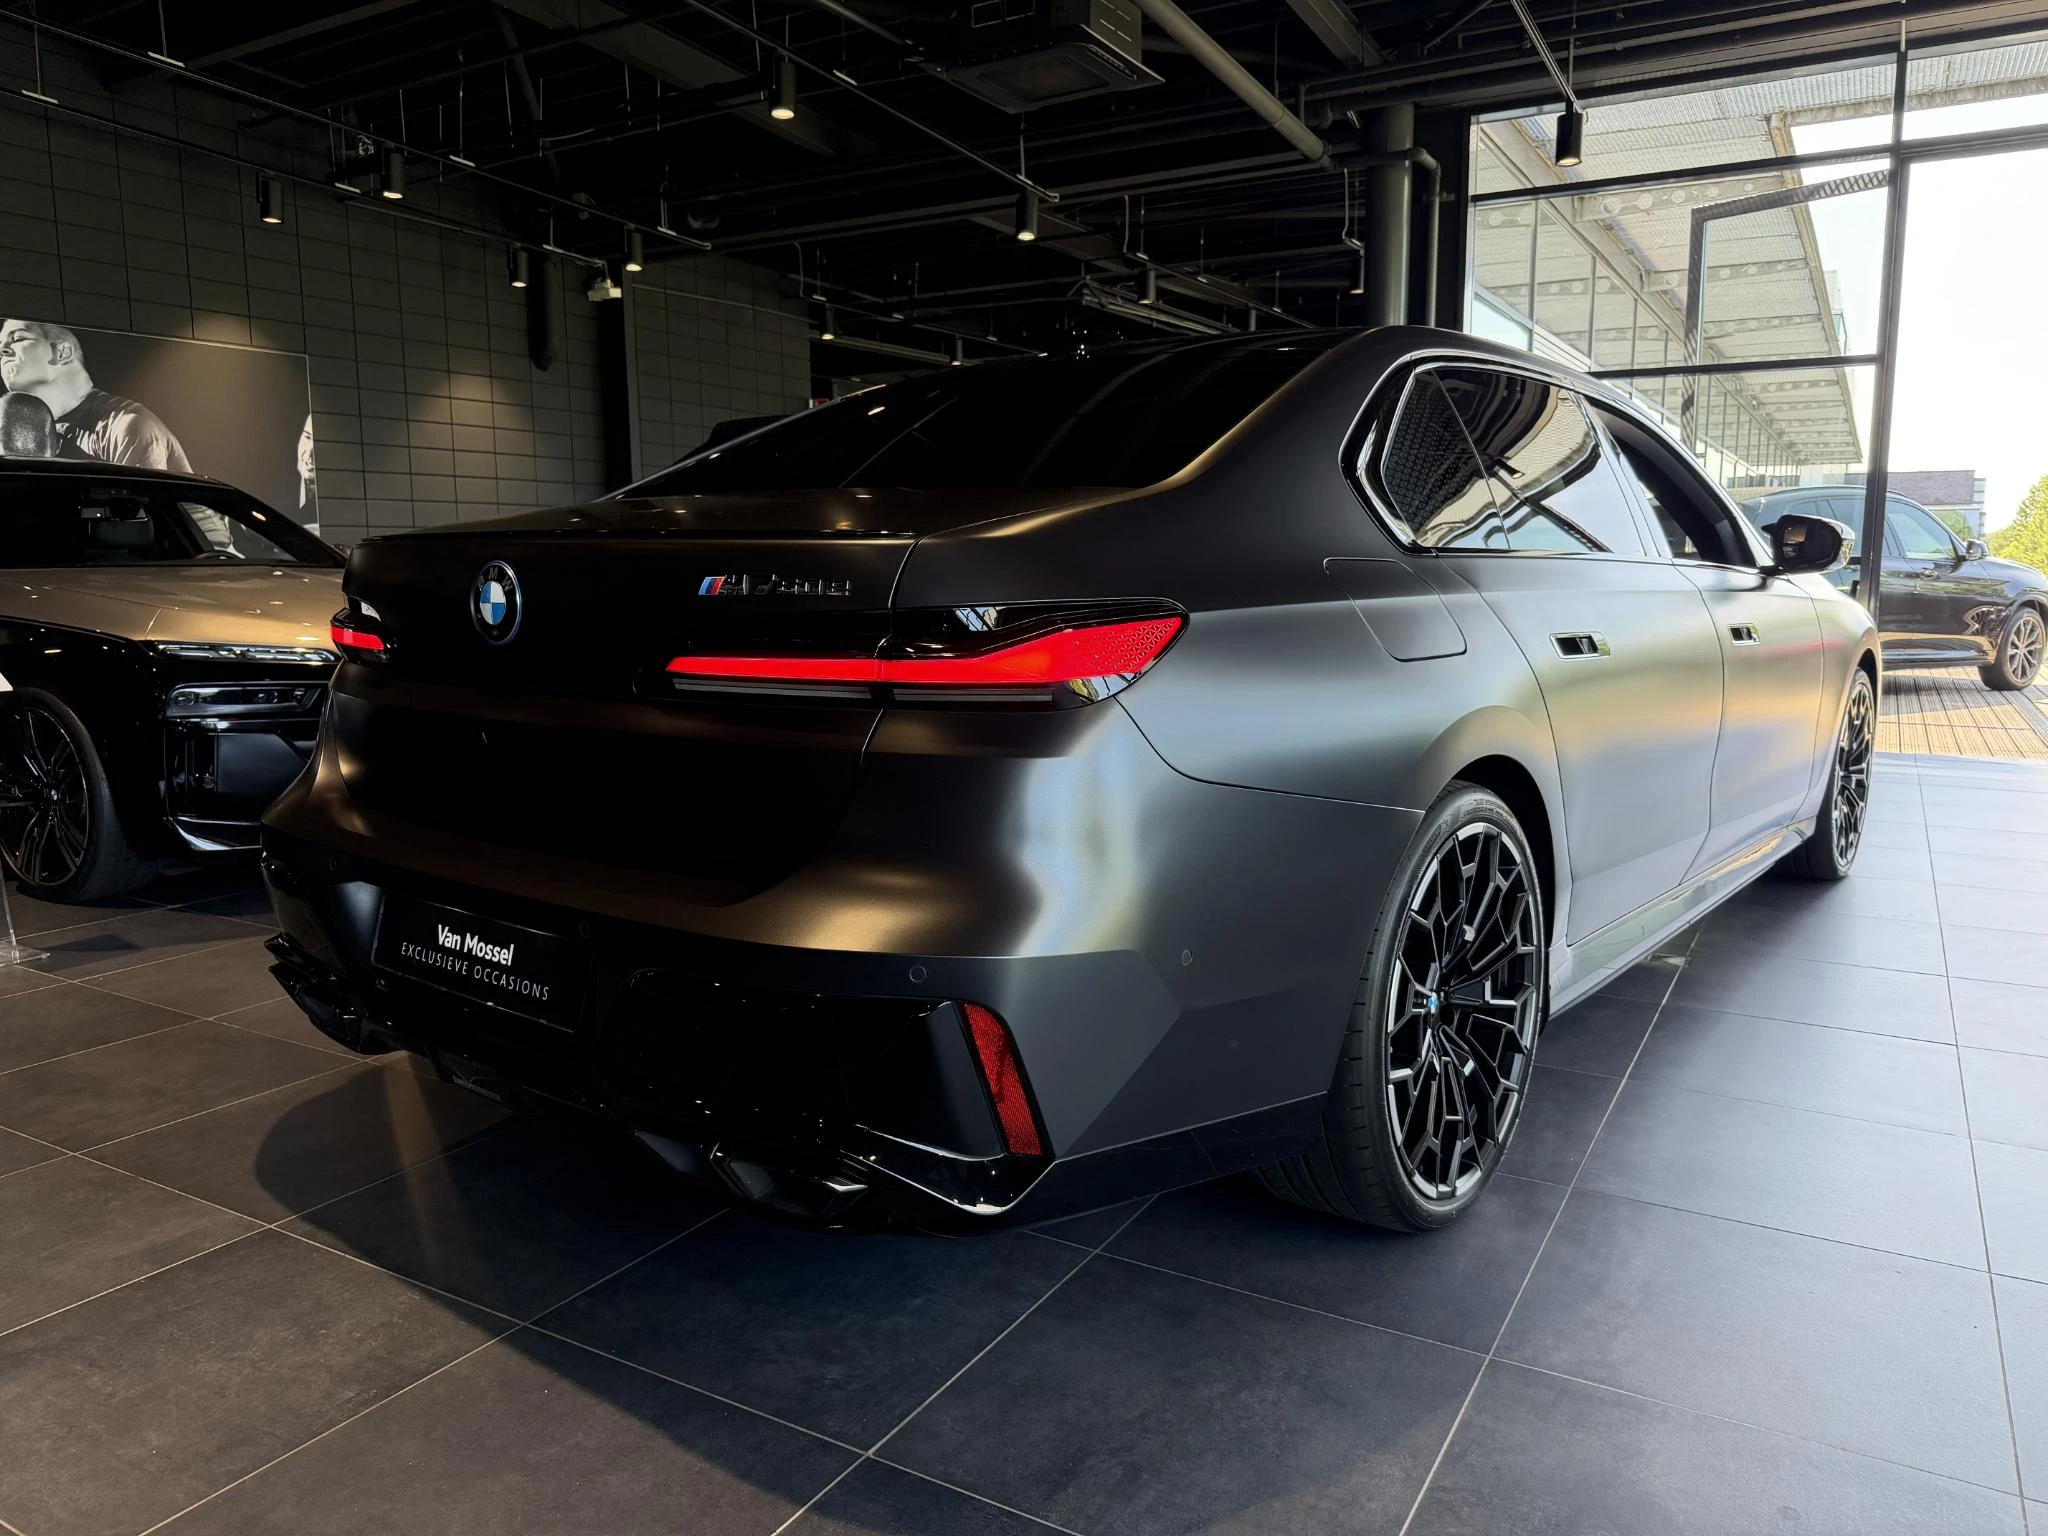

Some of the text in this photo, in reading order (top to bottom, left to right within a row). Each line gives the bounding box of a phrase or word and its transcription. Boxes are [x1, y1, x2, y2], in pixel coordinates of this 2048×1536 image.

[438, 924, 515, 966] Van Mossel
[401, 942, 550, 1000] EXCLUSIEVE OCCASIONS
